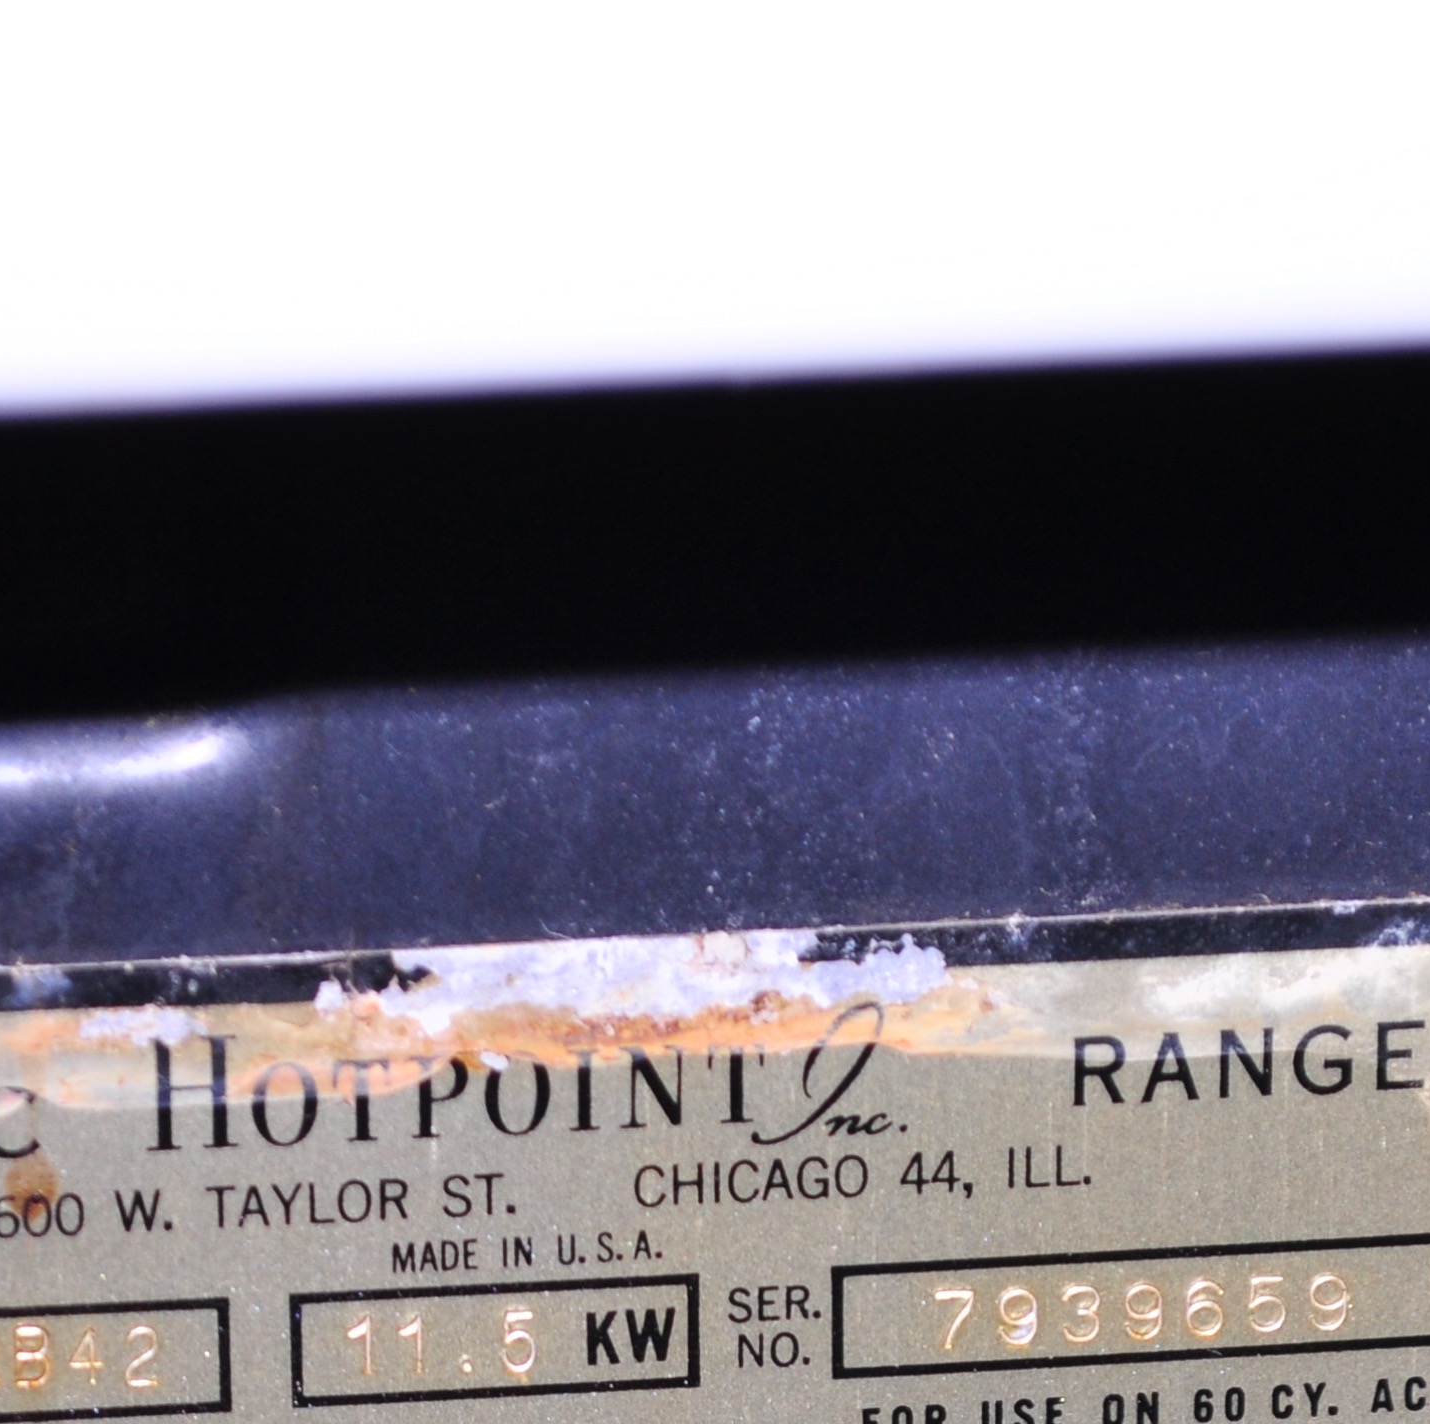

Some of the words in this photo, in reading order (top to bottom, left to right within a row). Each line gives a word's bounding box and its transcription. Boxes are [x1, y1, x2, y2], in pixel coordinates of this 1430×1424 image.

[145, 1034, 764, 1152] HOTPOINT
[750, 1001, 909, 1146] Inc.
[1073, 1019, 1426, 1106] RANGE
[114, 1188, 173, 1232] W.
[206, 1178, 410, 1229] TAYLOR
[442, 1172, 517, 1217] ST.
[634, 1153, 869, 1208] CHICAGO
[900, 1150, 975, 1199] 44,
[1006, 1145, 1093, 1190] ILL.
[391, 1239, 479, 1274] MADE
[501, 1236, 533, 1268] IN
[727, 1286, 822, 1324] SER.
[933, 1273, 1353, 1350] 7939659
[585, 1306, 676, 1366] KW
[737, 1332, 812, 1369] NO.
[1193, 1386, 1247, 1423] 60
[1271, 1381, 1340, 1420] CY.
